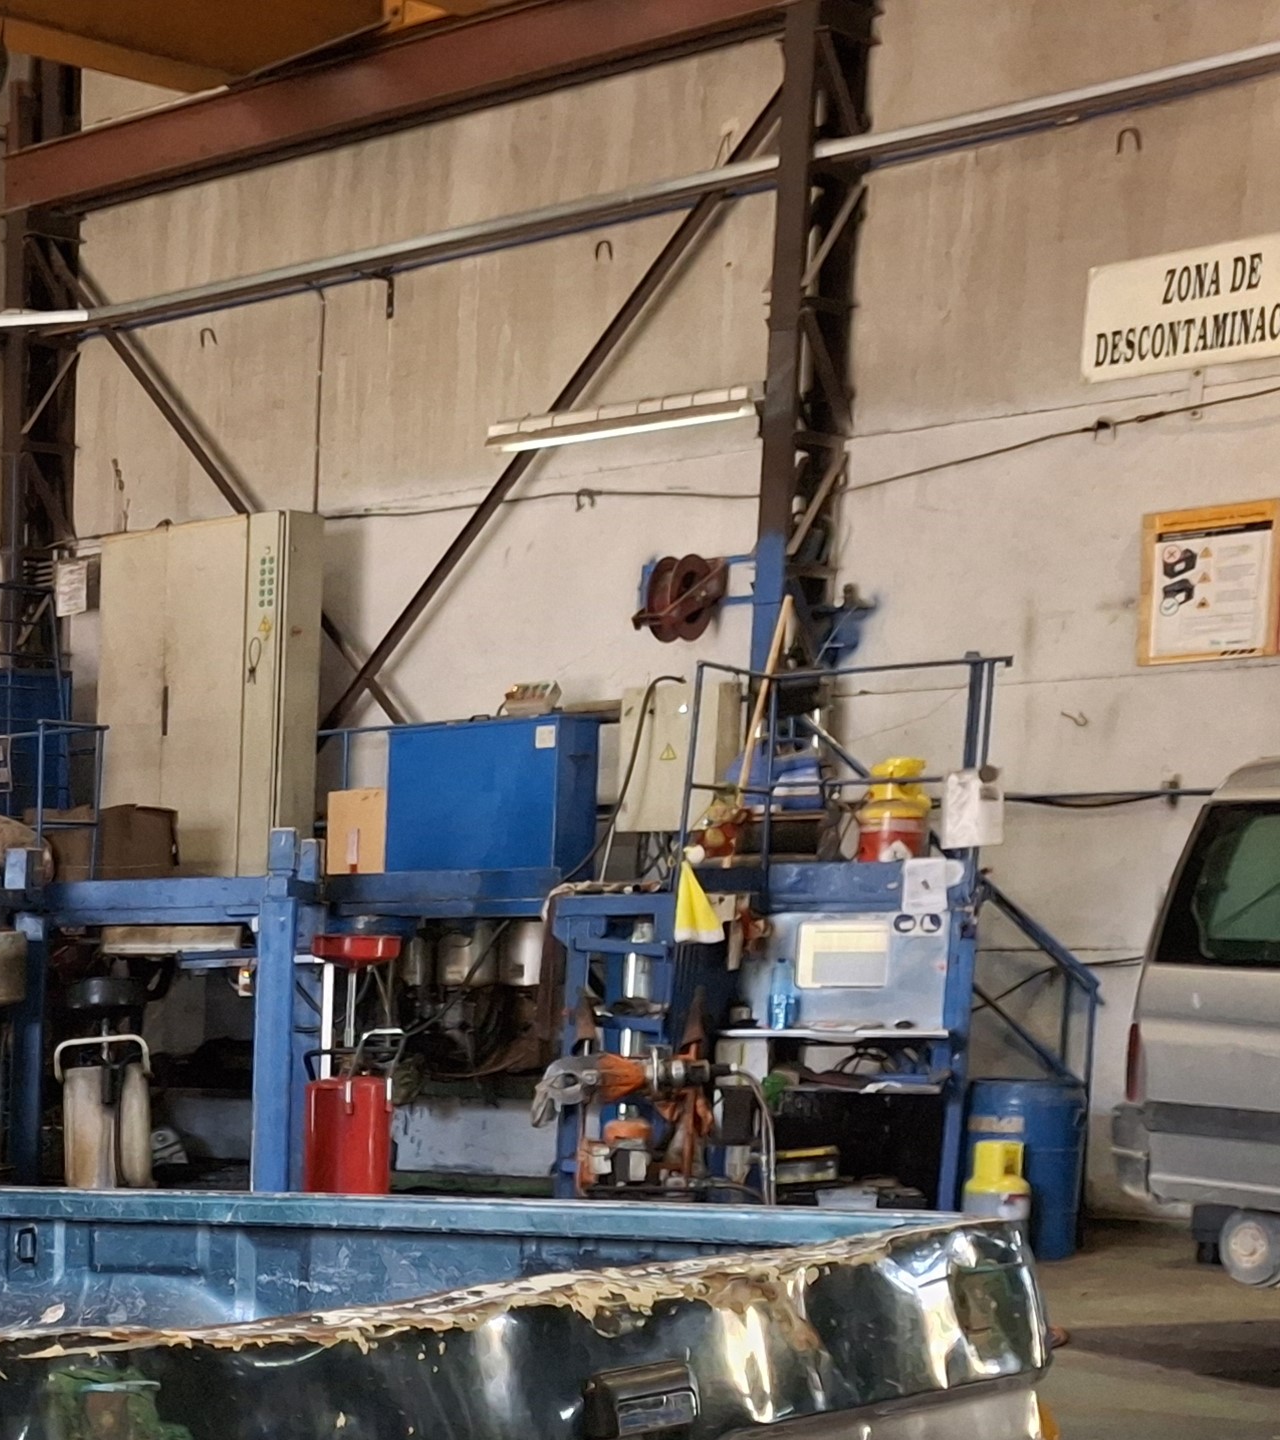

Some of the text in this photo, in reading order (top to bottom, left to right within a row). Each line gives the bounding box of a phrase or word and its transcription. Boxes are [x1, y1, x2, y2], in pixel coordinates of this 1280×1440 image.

[1161, 252, 1263, 305] ZONA DE
[1094, 303, 1280, 368] DESCONTAMINAC
